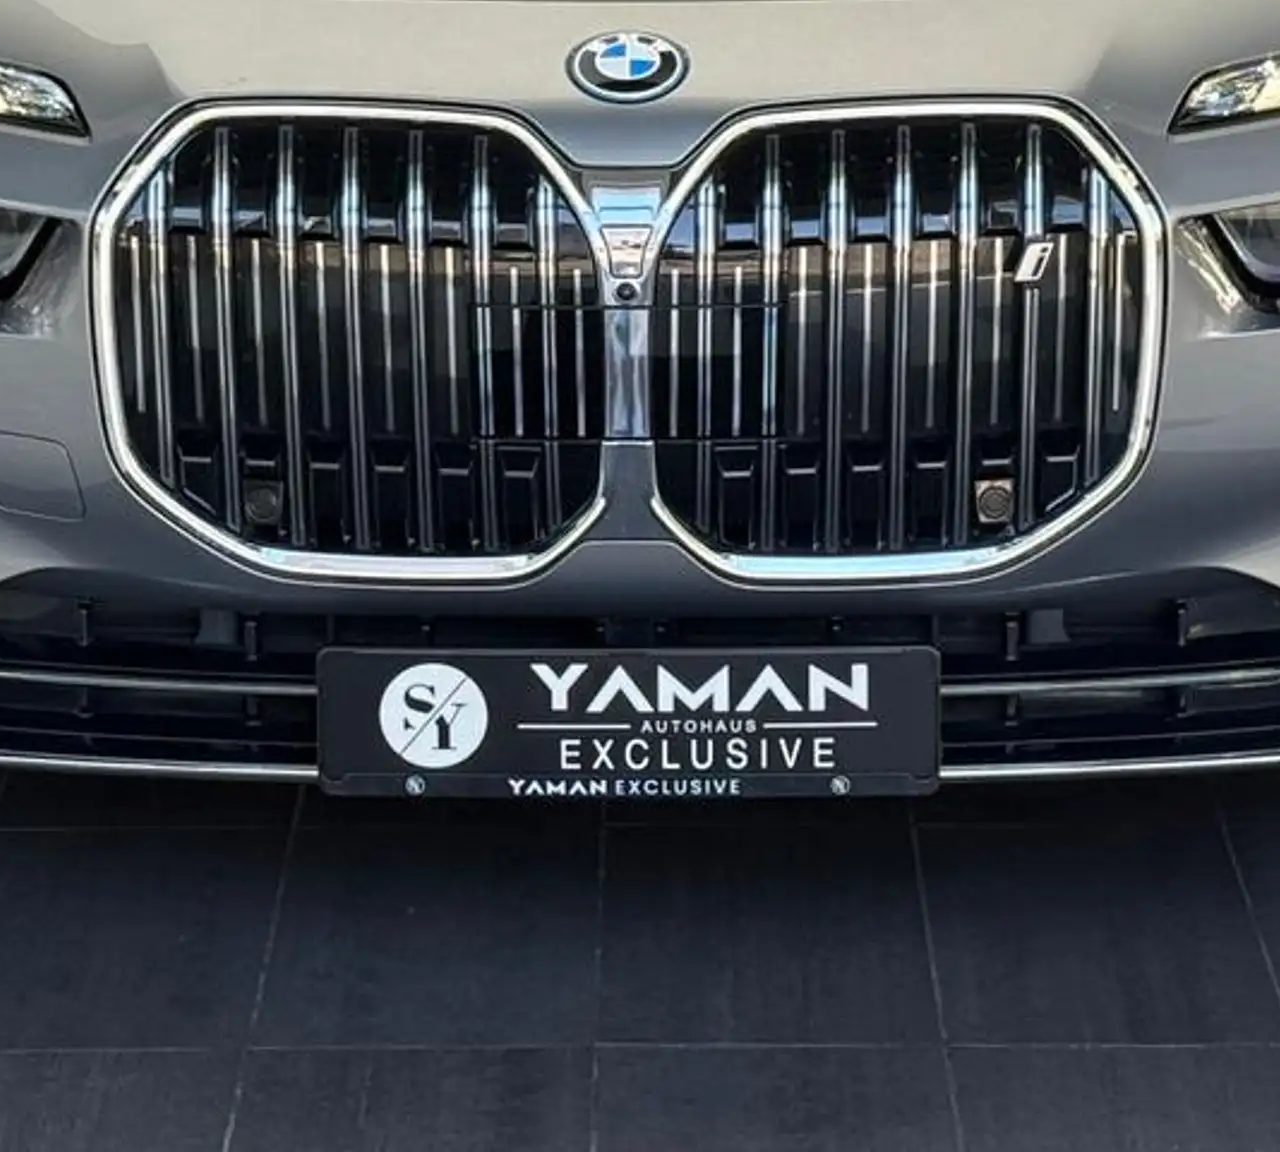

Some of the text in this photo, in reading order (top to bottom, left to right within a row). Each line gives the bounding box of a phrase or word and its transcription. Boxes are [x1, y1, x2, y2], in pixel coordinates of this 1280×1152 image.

[530, 662, 869, 713] YAMAN
[640, 719, 758, 734] AUTOHAUS
[559, 737, 836, 771] EXCLUSIVE
[508, 777, 741, 796] YAMAN EXCLUSIVE
